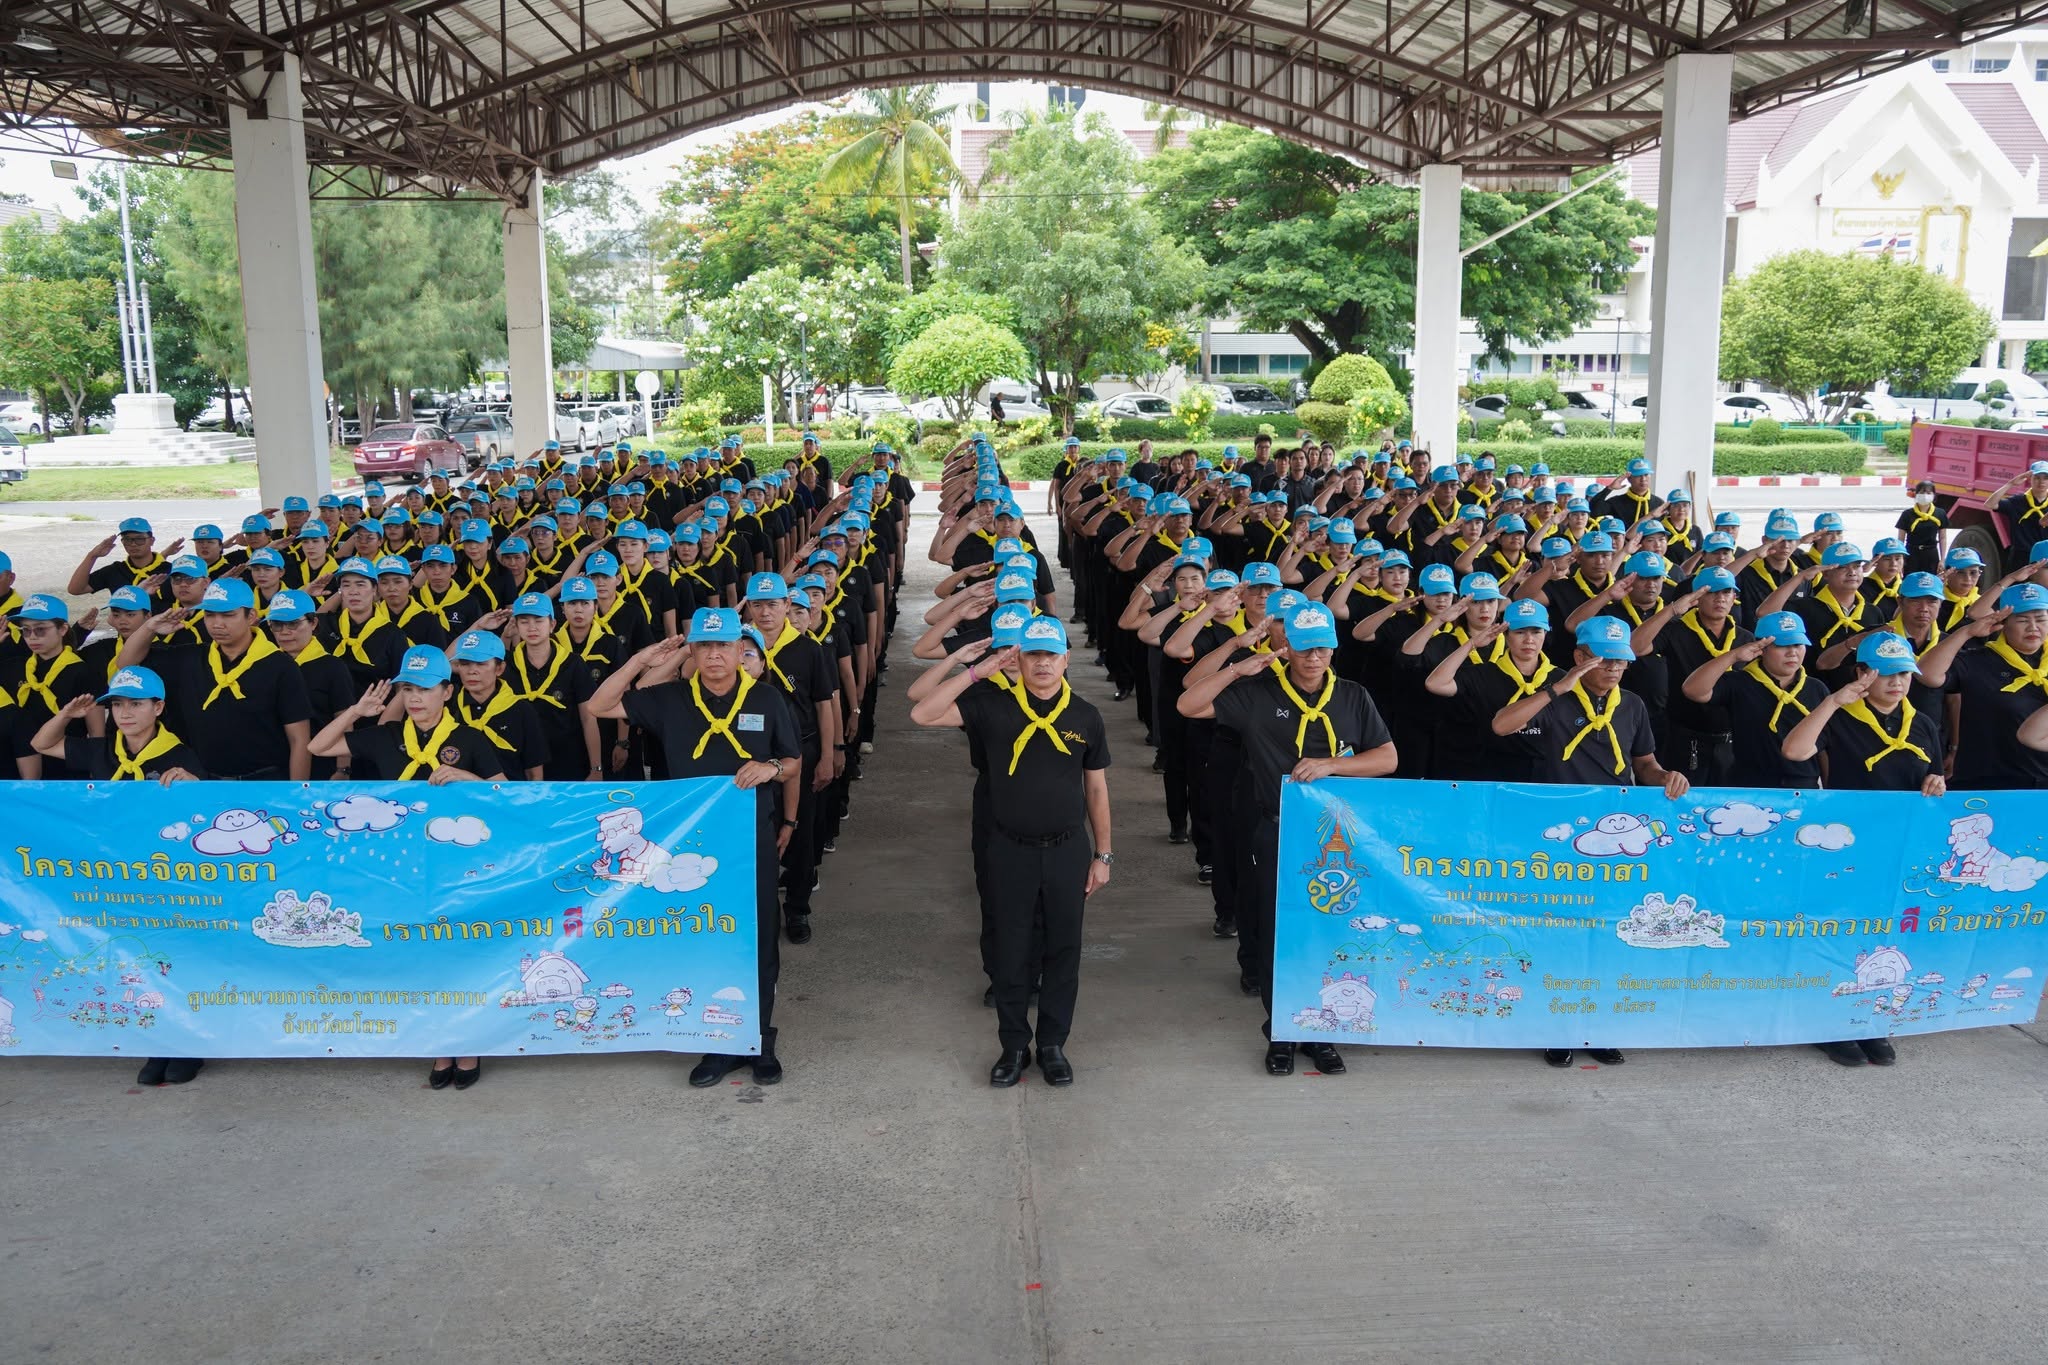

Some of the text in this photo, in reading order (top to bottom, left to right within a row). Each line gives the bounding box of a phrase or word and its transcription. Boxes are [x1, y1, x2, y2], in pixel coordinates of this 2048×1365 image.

[15, 846, 277, 882] โครงการจิตอาสา
[1397, 845, 1648, 882] โครงการจิตอาสา
[72, 885, 224, 907] หน่วยพระราชทาน
[1445, 884, 1595, 905] หน่วยพระราชทาน
[58, 912, 240, 931] และประชาชนจิตอาสา
[383, 903, 737, 941] เราทำความ ดี ด้วยหัวใจ
[1431, 910, 1607, 930] และประชาชนจิตอาสา
[1740, 902, 2047, 938] เราทำความ ดี ด้วยหัวใจ
[187, 980, 488, 1011] ศูนย์อำนวยการจิตอาสาพระราชทาน
[1612, 995, 1657, 1013] ยโสธร
[282, 1011, 397, 1034] จังหวัดยโสธร
